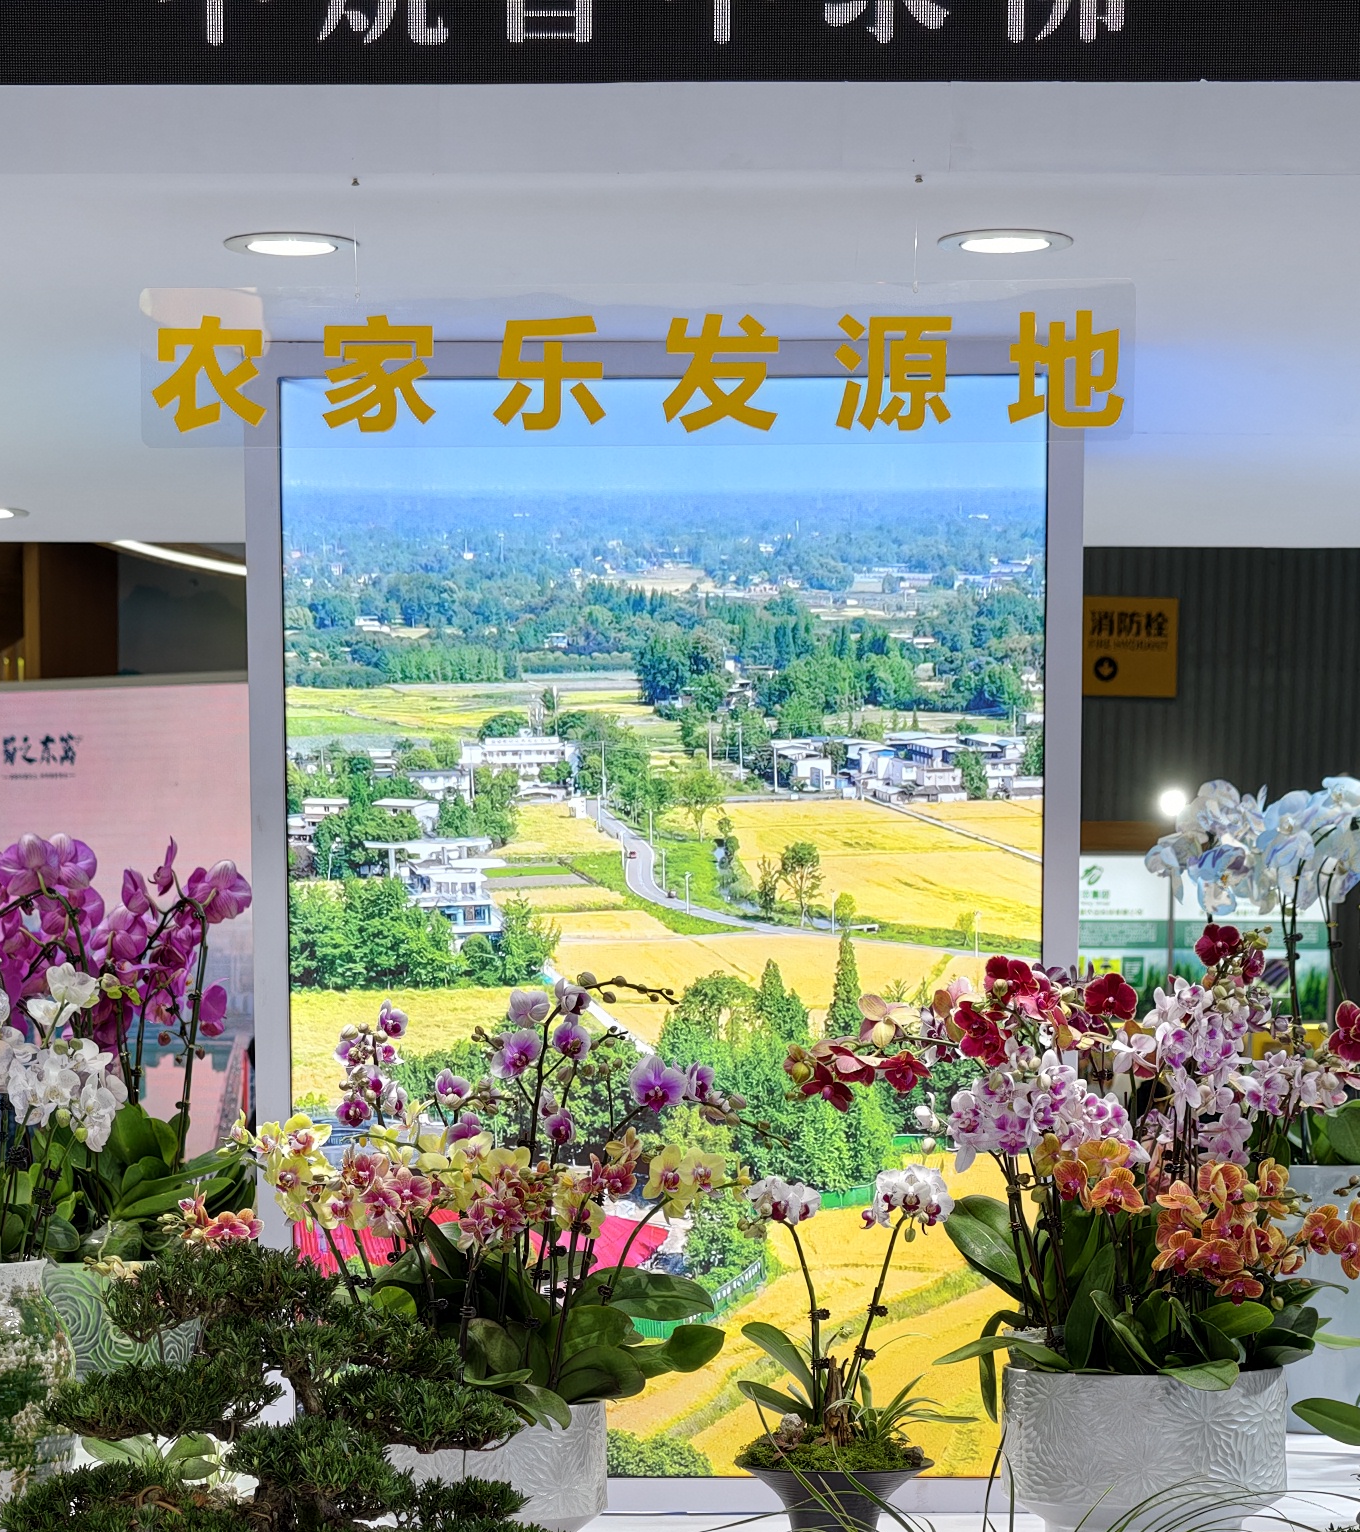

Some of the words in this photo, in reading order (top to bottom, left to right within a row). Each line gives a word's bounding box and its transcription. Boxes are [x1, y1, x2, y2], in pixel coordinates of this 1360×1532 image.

[151, 309, 1126, 433] 农家乐发源地
[1089, 609, 1169, 637] 消防栓
